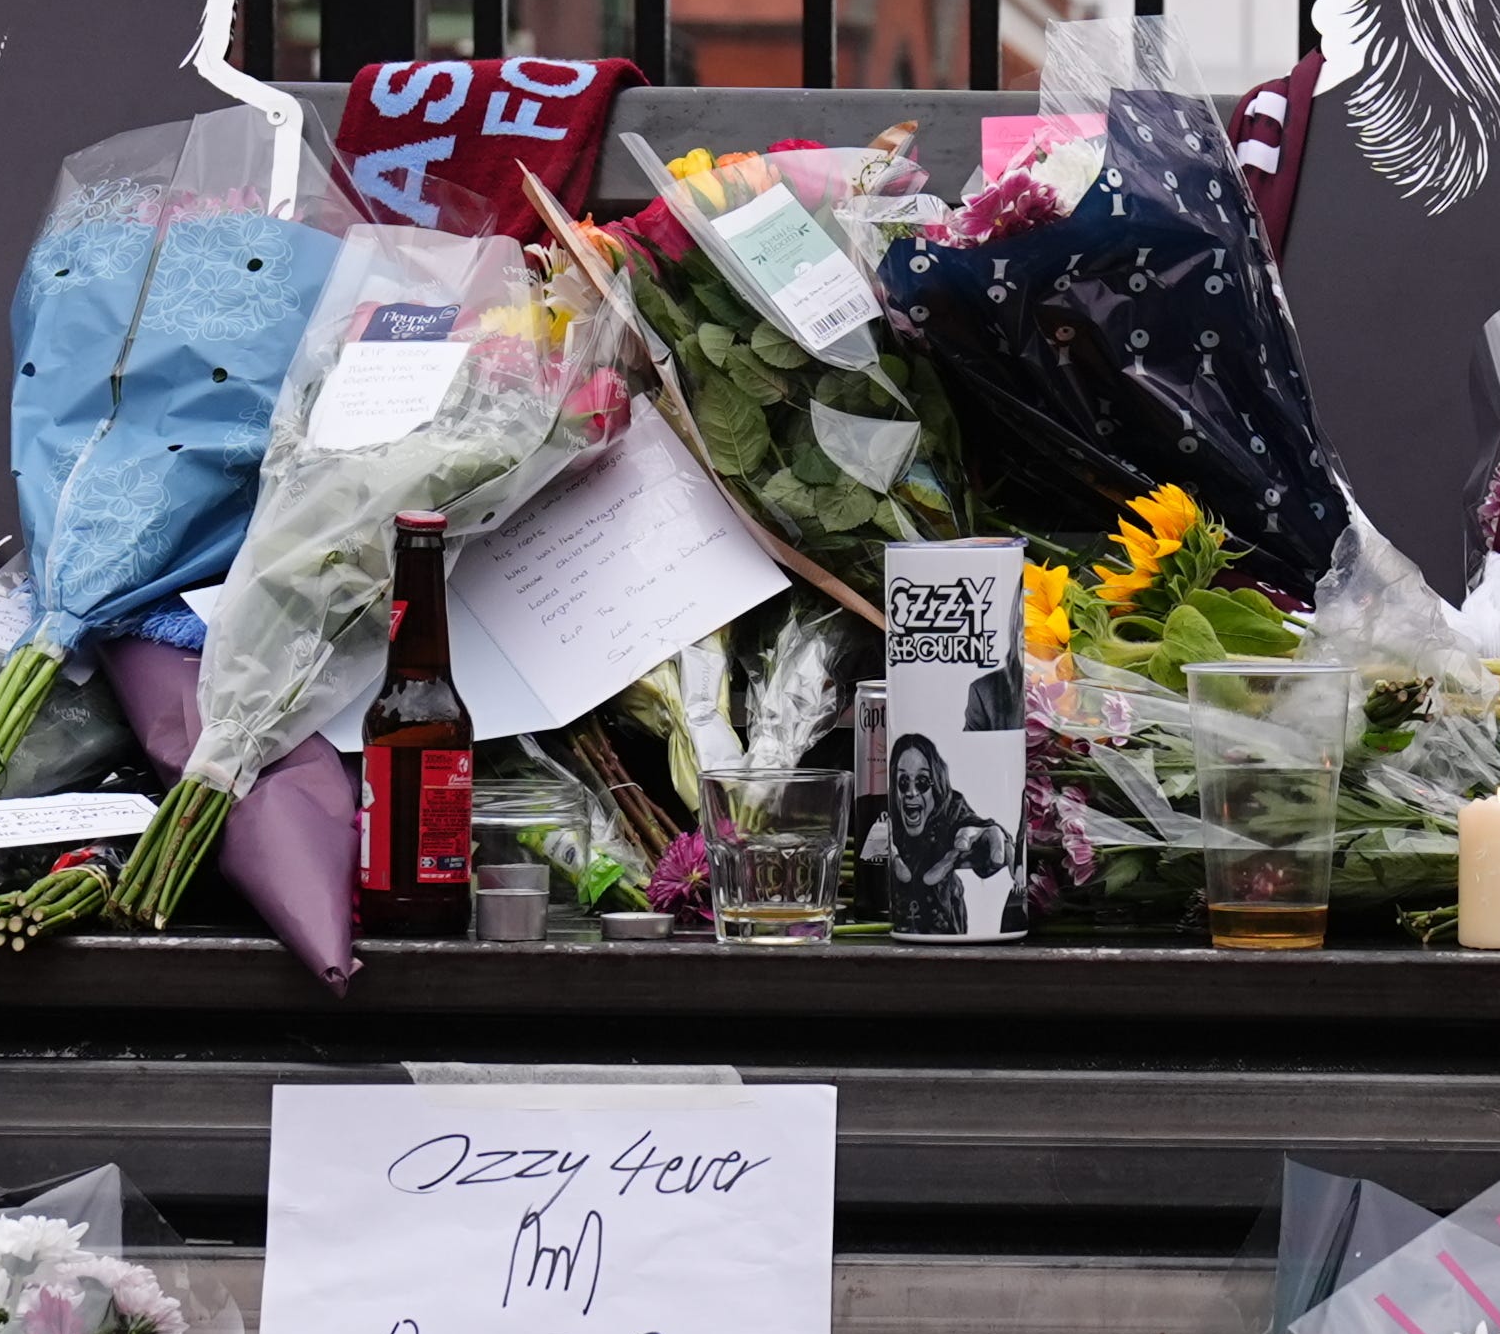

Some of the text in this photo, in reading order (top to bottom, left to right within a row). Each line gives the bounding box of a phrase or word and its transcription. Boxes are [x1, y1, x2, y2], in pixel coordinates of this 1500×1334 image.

[382, 310, 438, 324] Flourish
[886, 577, 996, 635] OZZY
[858, 701, 887, 733] Capt
[609, 1129, 773, 1196] 4ever
